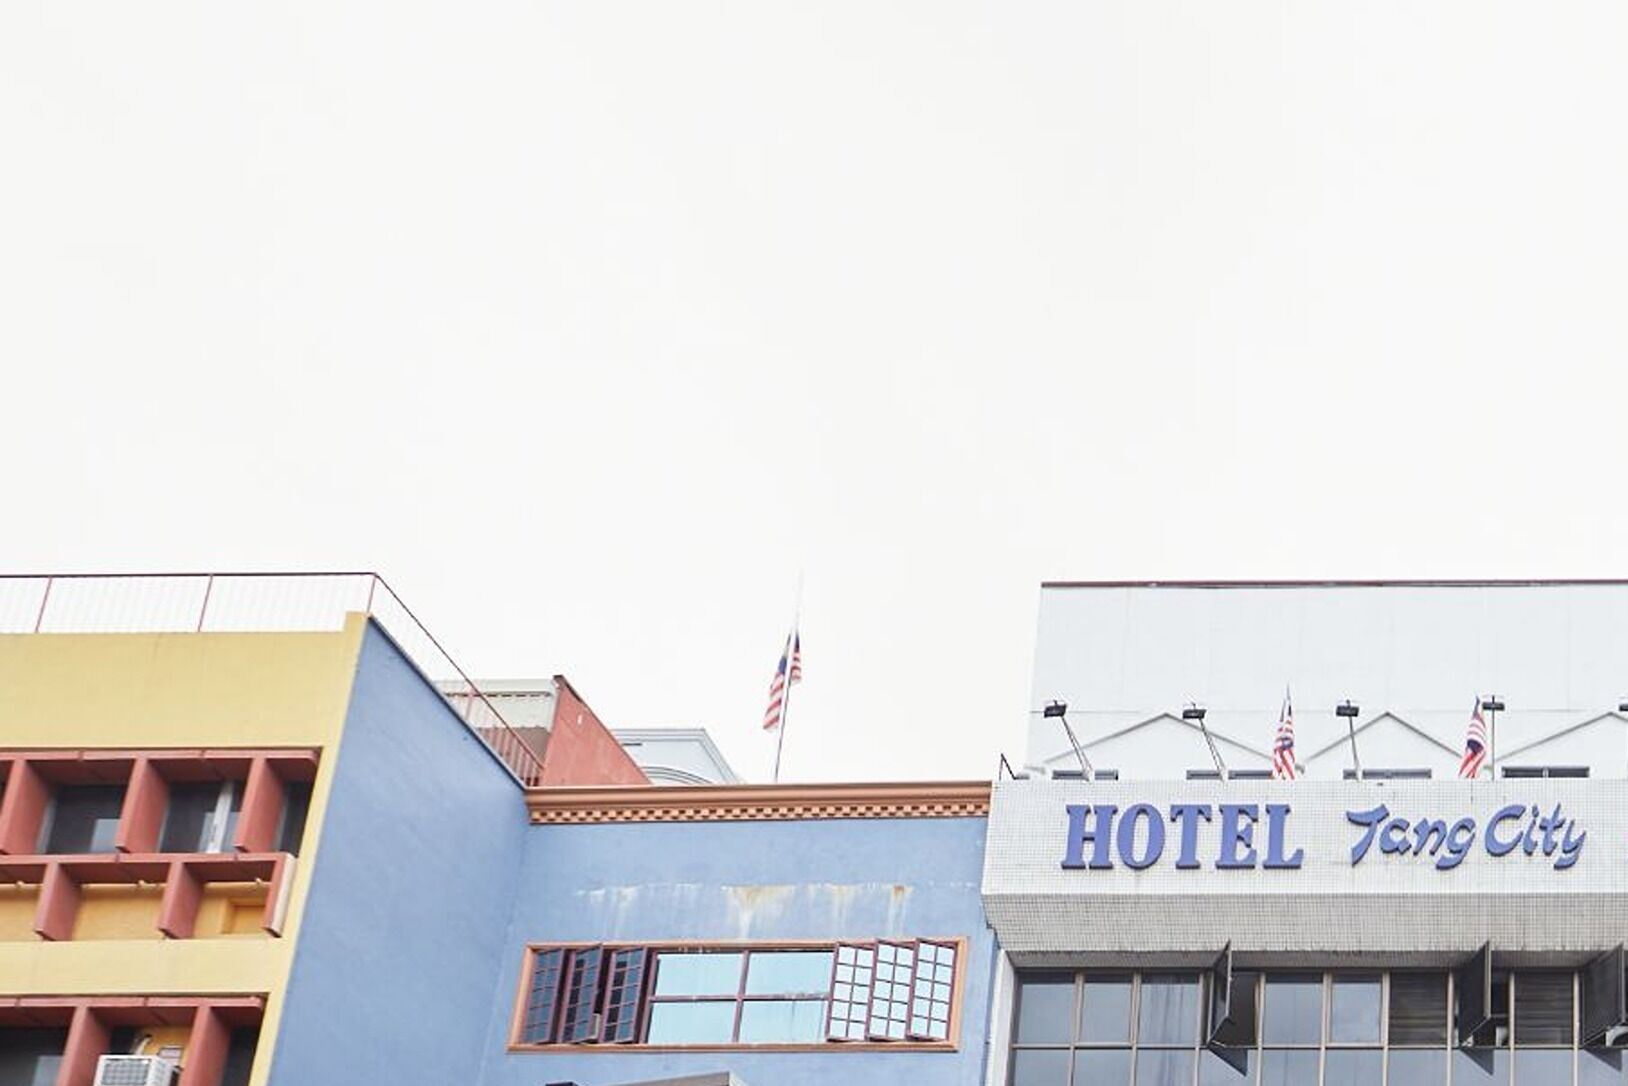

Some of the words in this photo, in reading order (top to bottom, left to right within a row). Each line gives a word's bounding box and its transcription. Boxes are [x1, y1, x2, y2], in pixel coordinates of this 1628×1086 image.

[1060, 803, 1304, 870] HOTEL
[1345, 804, 1476, 870] Tang
[1483, 803, 1588, 870] City
